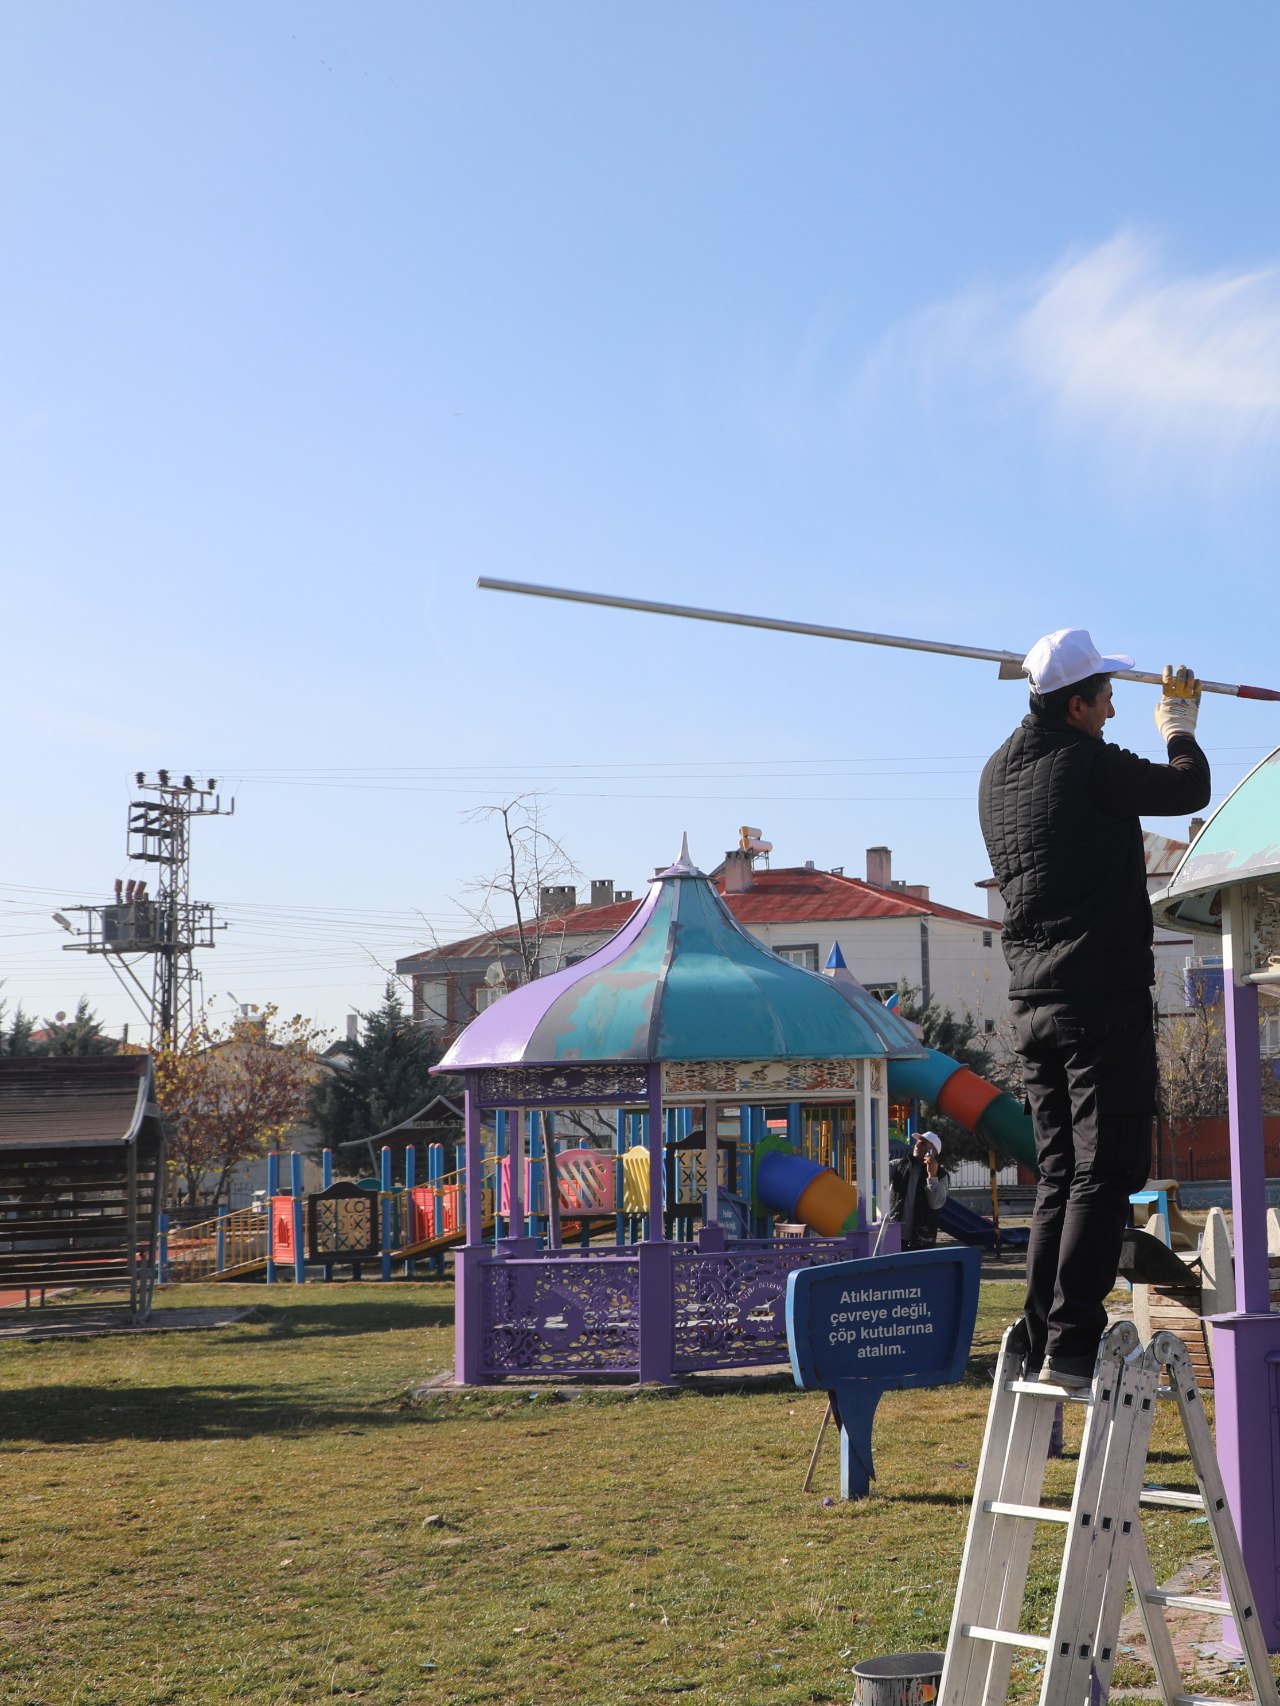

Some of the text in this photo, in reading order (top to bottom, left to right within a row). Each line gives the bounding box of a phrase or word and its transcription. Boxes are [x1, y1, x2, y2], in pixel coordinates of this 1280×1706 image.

[840, 1288, 921, 1304] Atıklarımızı
[830, 1303, 932, 1327] çevreye değil,
[829, 1322, 933, 1345] çöp kutularına
[857, 1343, 906, 1358] atalım.
